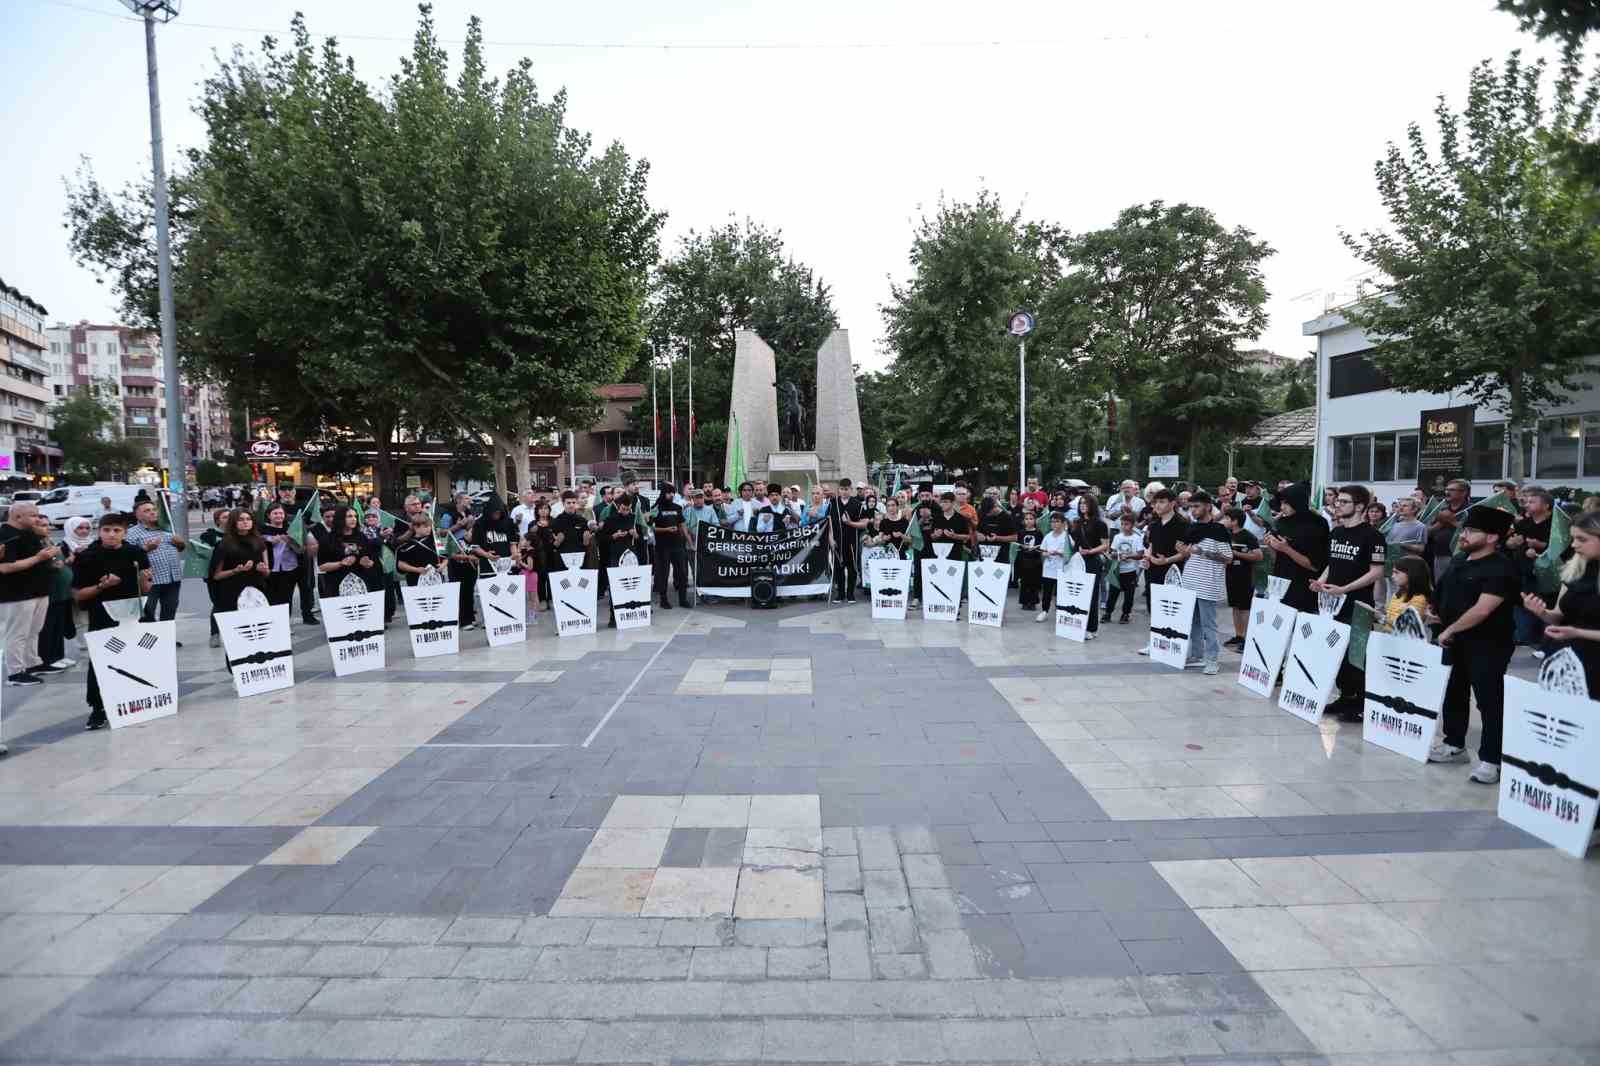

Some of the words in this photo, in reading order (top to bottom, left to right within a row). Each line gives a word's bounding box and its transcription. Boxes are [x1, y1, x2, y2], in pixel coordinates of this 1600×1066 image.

[707, 526, 725, 539] 21
[732, 532, 779, 543] MAYIS
[787, 523, 820, 539] 1864
[707, 541, 752, 552] ÇERKES
[1370, 709, 1380, 722] 21
[1381, 713, 1403, 730] MAYIS
[1404, 720, 1423, 737] 1864
[1510, 778, 1521, 793] 21
[1523, 783, 1553, 811] MAYIS
